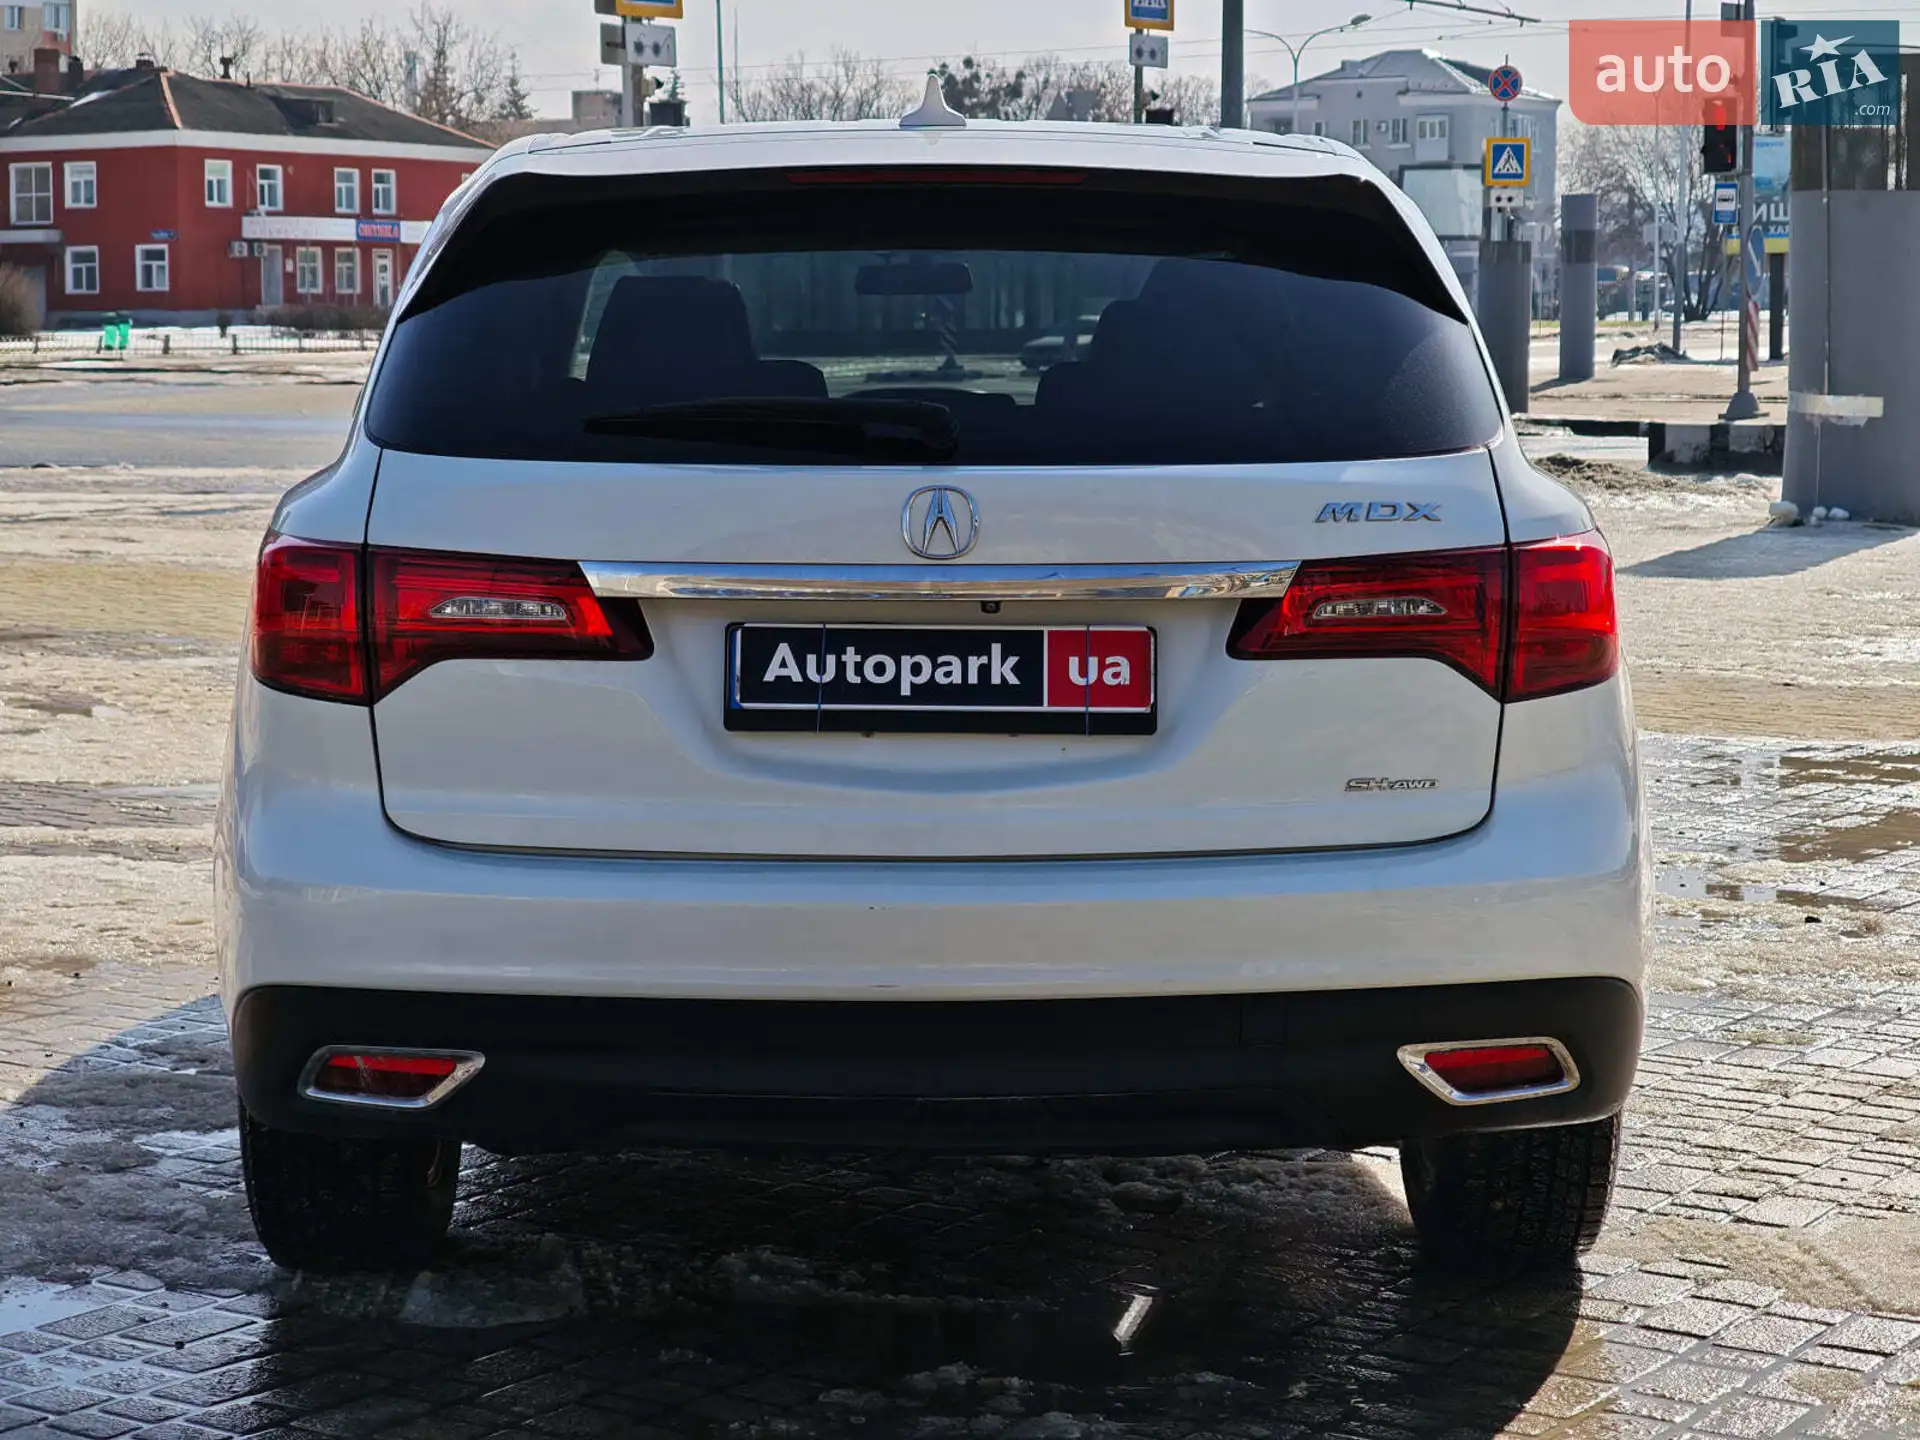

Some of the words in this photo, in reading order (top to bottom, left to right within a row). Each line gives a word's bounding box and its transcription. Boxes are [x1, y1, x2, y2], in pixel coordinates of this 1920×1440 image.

[1314, 501, 1443, 523] MDX
[763, 642, 1021, 696] Autopark
[1068, 655, 1131, 686] ua
